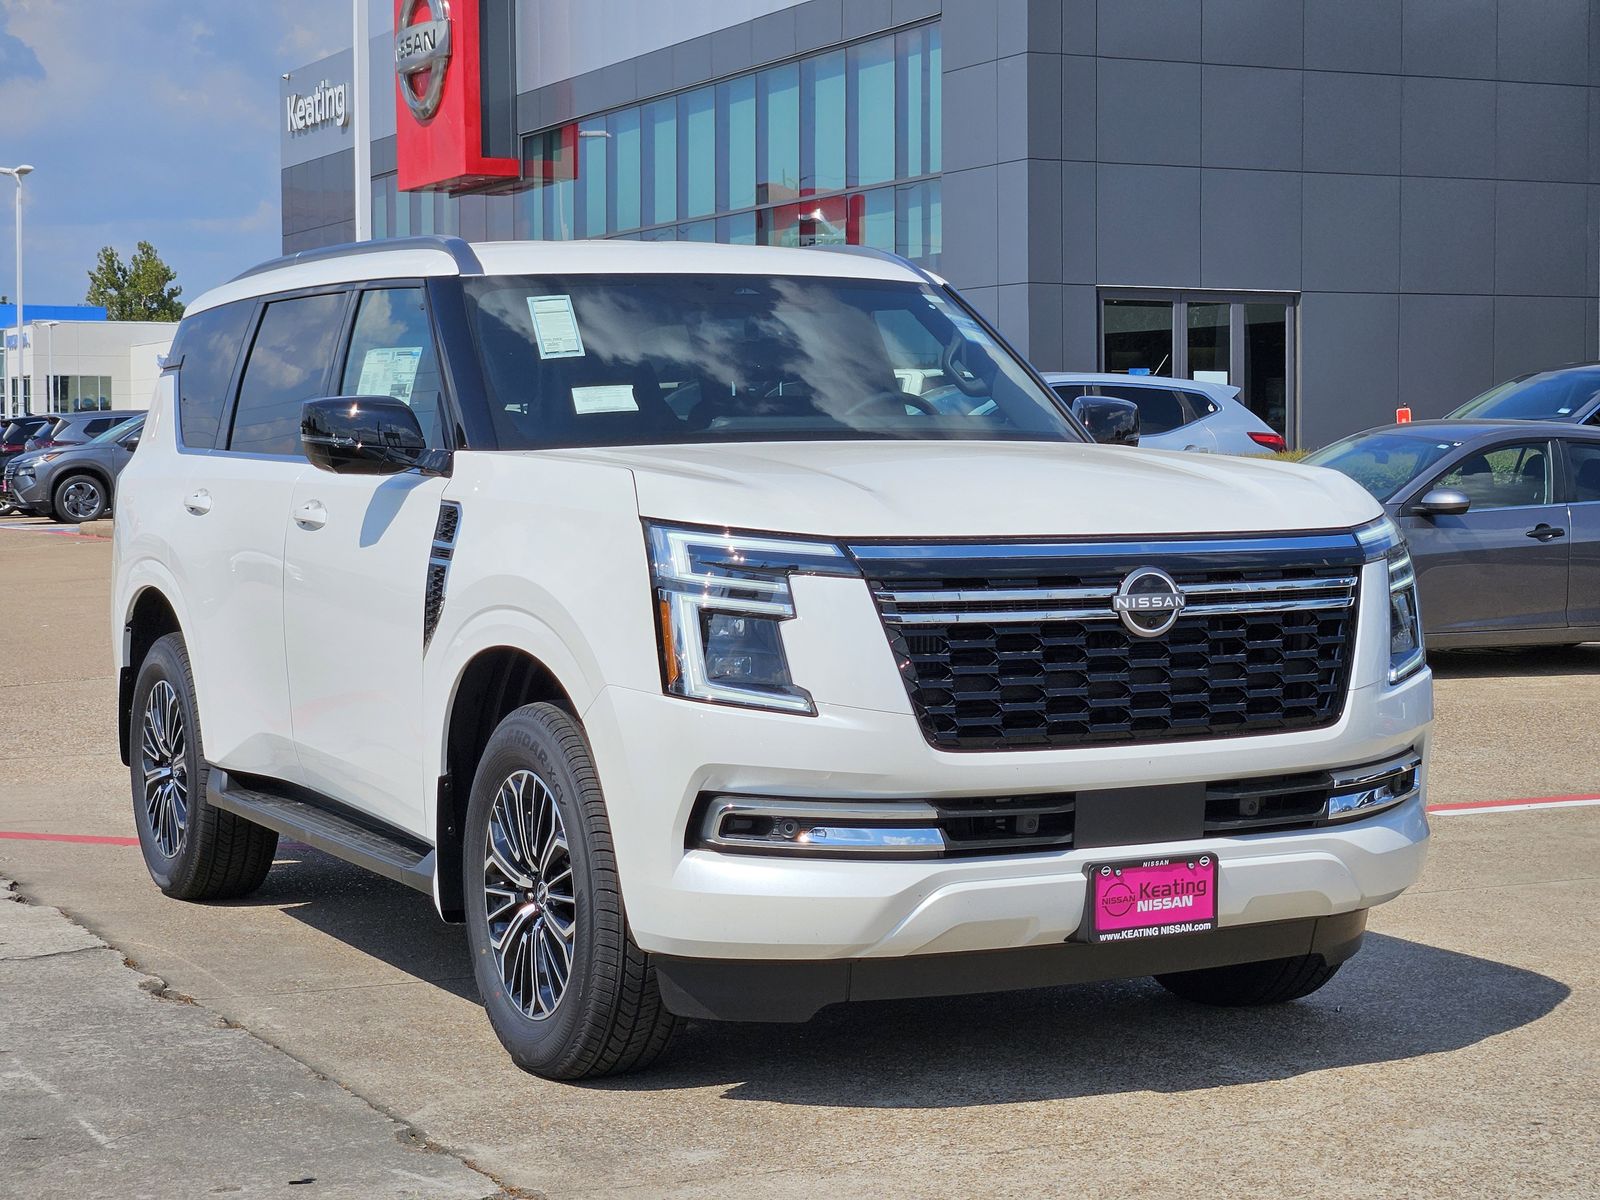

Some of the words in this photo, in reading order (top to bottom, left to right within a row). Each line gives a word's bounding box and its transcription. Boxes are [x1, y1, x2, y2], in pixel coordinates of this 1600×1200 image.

[287, 80, 345, 132] Keating
[1117, 596, 1184, 608] NISSAN
[1142, 859, 1169, 868] NISSAN
[1139, 879, 1206, 899] Keating
[1102, 895, 1135, 905] NISSAN
[1137, 895, 1193, 912] NISSAN
[1100, 927, 1158, 941] www.KEATING
[1161, 923, 1211, 935] NISSAN.com
